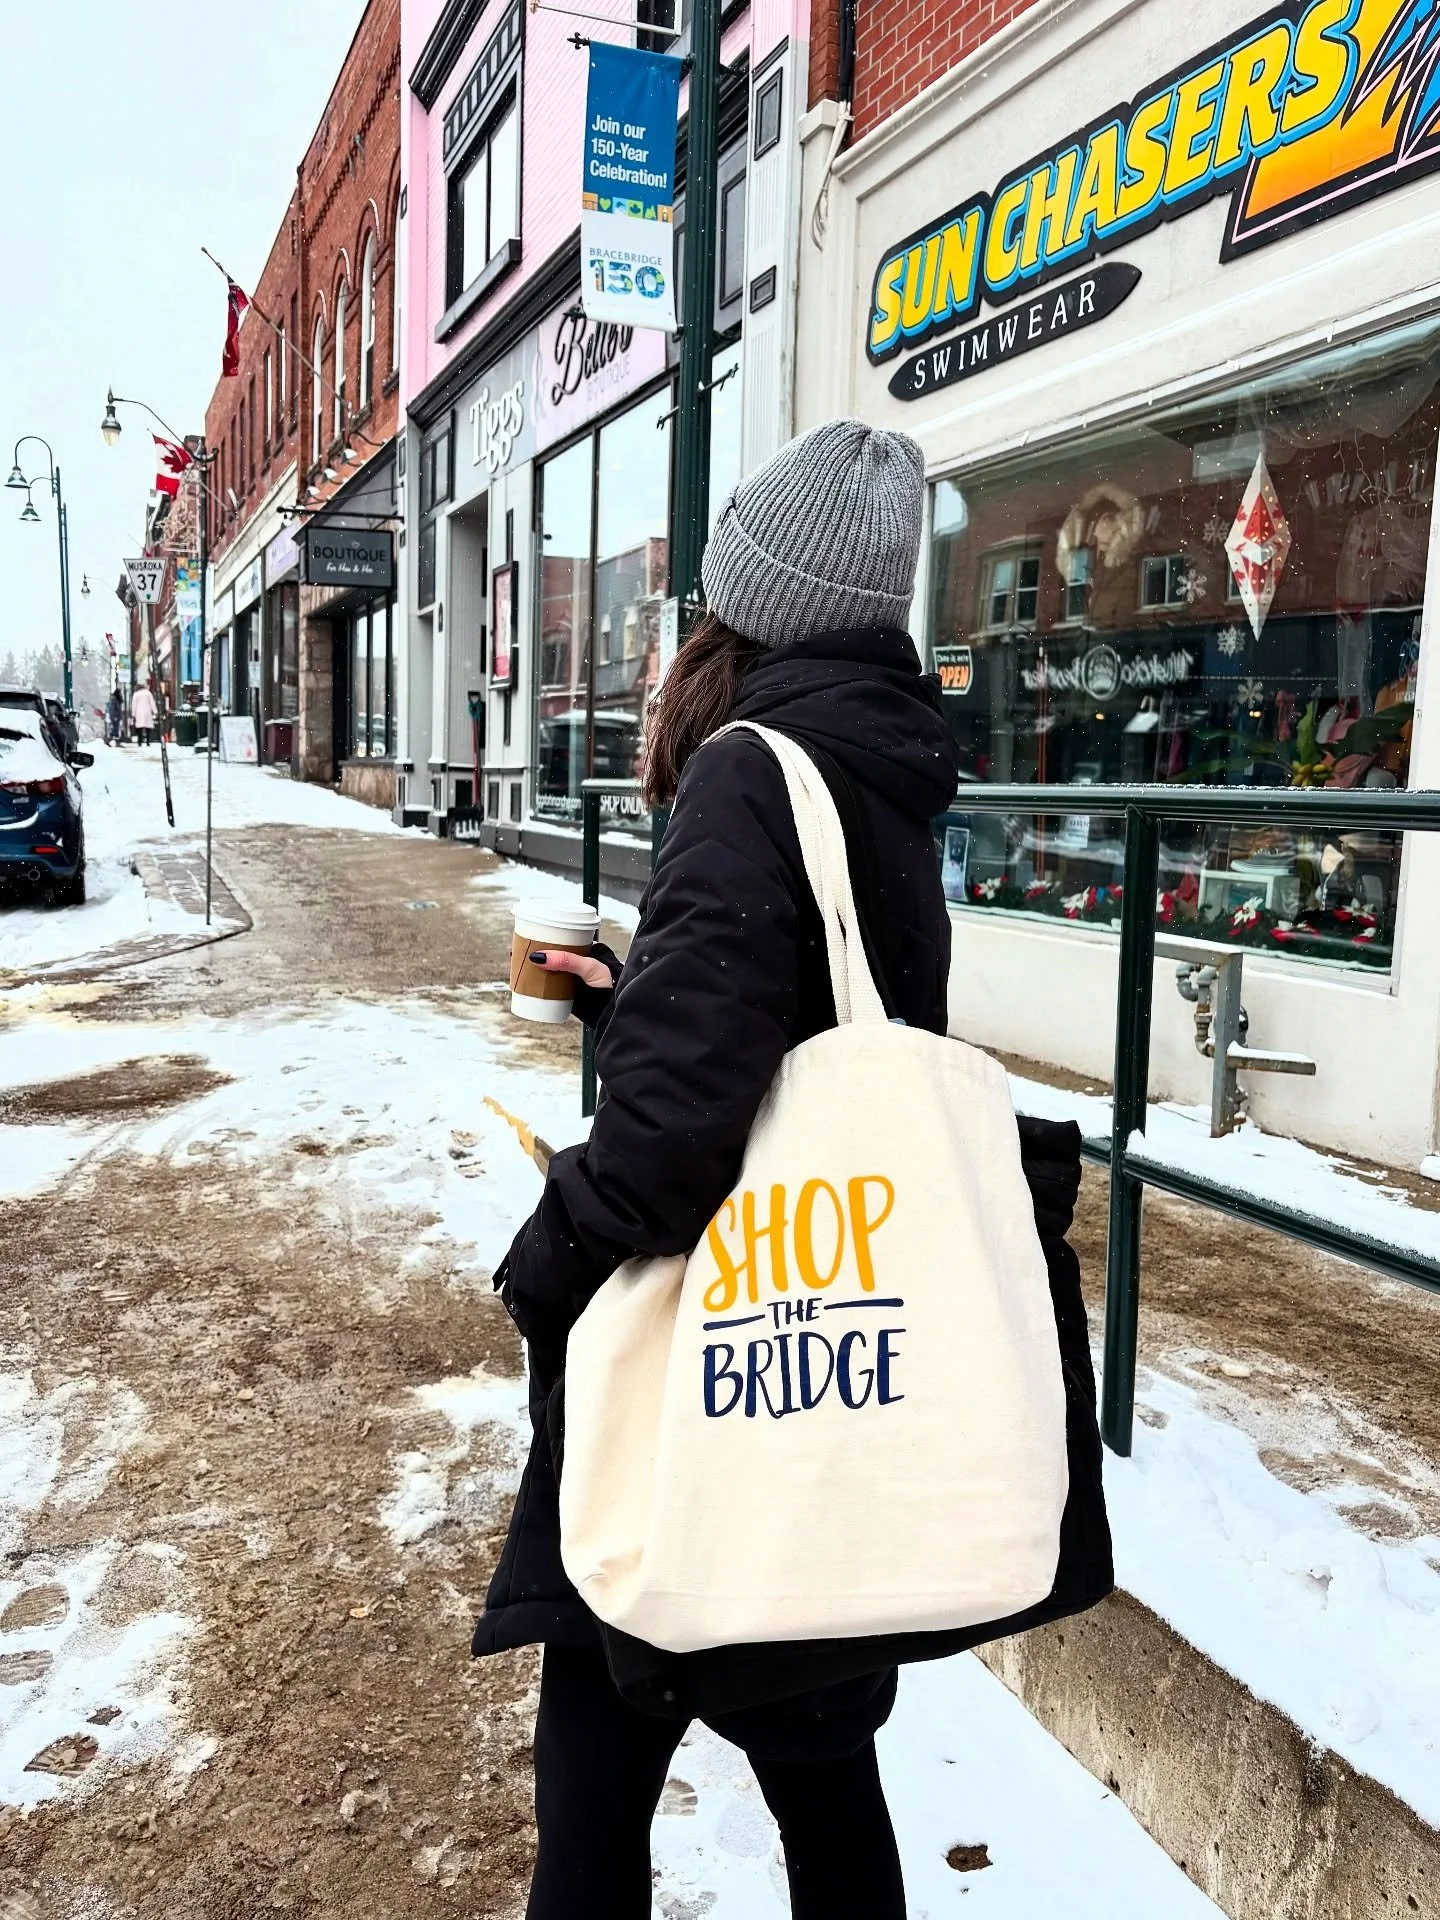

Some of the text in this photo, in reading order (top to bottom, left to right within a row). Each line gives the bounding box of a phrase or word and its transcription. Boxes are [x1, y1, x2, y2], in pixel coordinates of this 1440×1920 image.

[591, 114, 647, 140] Join our
[591, 137, 650, 164] 150-Year
[589, 158, 668, 189] Celebration!
[870, 0, 1360, 355] SUN CHASERS
[588, 246, 664, 267] BRACEBRIDGE
[589, 258, 666, 300] 150
[913, 278, 1097, 390] SWIMWEAR
[469, 379, 524, 474] Tiggs
[127, 561, 164, 572] MUSKOKA
[313, 545, 387, 563] BOUTIQUE
[137, 573, 158, 592] 37
[939, 665, 969, 689] OPEN
[599, 795, 620, 813] SHOP
[702, 1174, 896, 1314] SHOP
[766, 1296, 824, 1330] THE
[701, 1327, 908, 1420] BRIDGE
